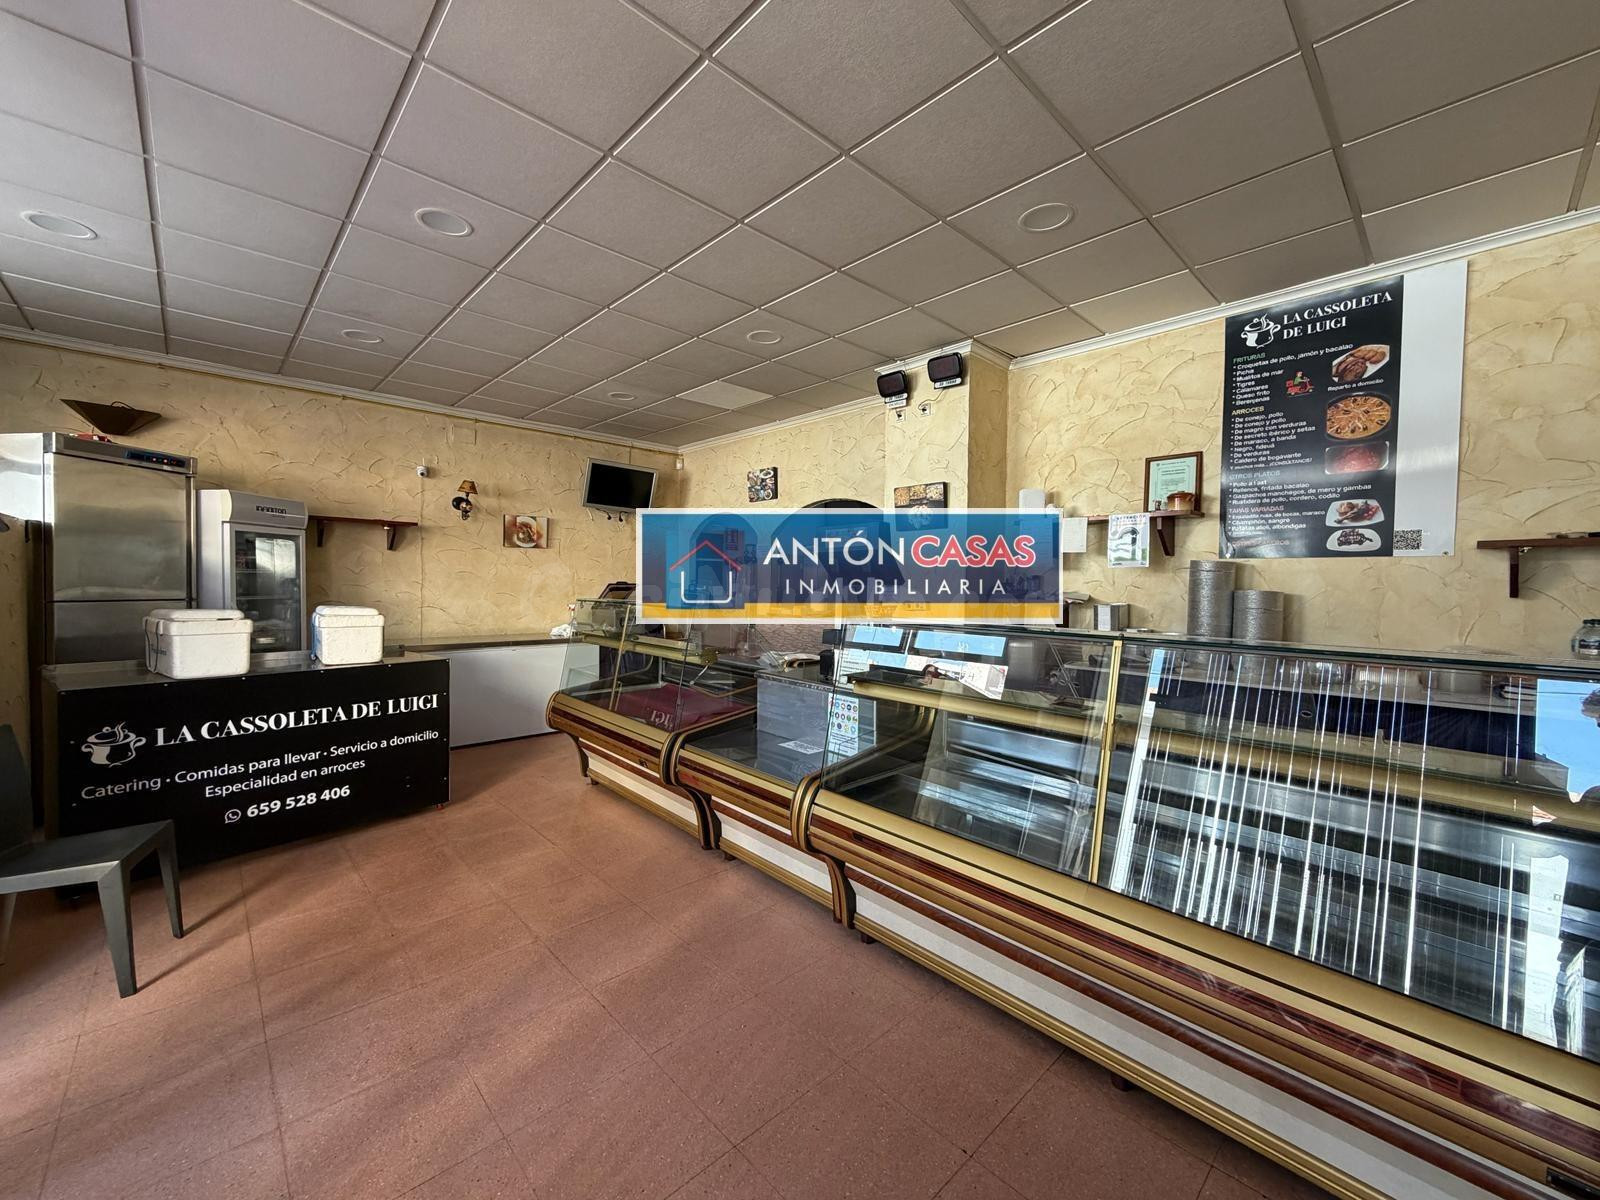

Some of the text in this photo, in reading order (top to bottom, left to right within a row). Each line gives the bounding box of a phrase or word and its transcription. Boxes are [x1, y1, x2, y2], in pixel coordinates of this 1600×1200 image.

[1283, 291, 1393, 325] LA CASSOLETA
[1283, 316, 1347, 340] DE LUIGI
[1233, 352, 1265, 364] FRITURAS
[1237, 360, 1268, 370] Croquetas
[1279, 355, 1296, 363] pollo,
[1297, 351, 1319, 359] jamón
[1325, 343, 1353, 353] bacalao
[1236, 384, 1268, 393] Calamares
[1236, 392, 1255, 400] Queso
[1232, 406, 1264, 415] ARROCES
[1244, 426, 1264, 434] magro
[1279, 421, 1306, 429] verduras
[1245, 420, 1264, 428] conejo
[1269, 428, 1290, 436] ibérico
[1268, 453, 1301, 461] bogavante
[1254, 470, 1280, 479] PLATOS
[1343, 484, 1371, 492] gambas
[1318, 492, 1340, 500] codillo
[1251, 505, 1284, 513] VARIADAS
[155, 694, 439, 747] LA CASSOLETA DE LUIGI
[80, 729, 439, 800] Catering Comidas para llevar Servicio a domicilio
[205, 759, 366, 799] Especialidad en arroces
[247, 786, 351, 819] 659 528 406
